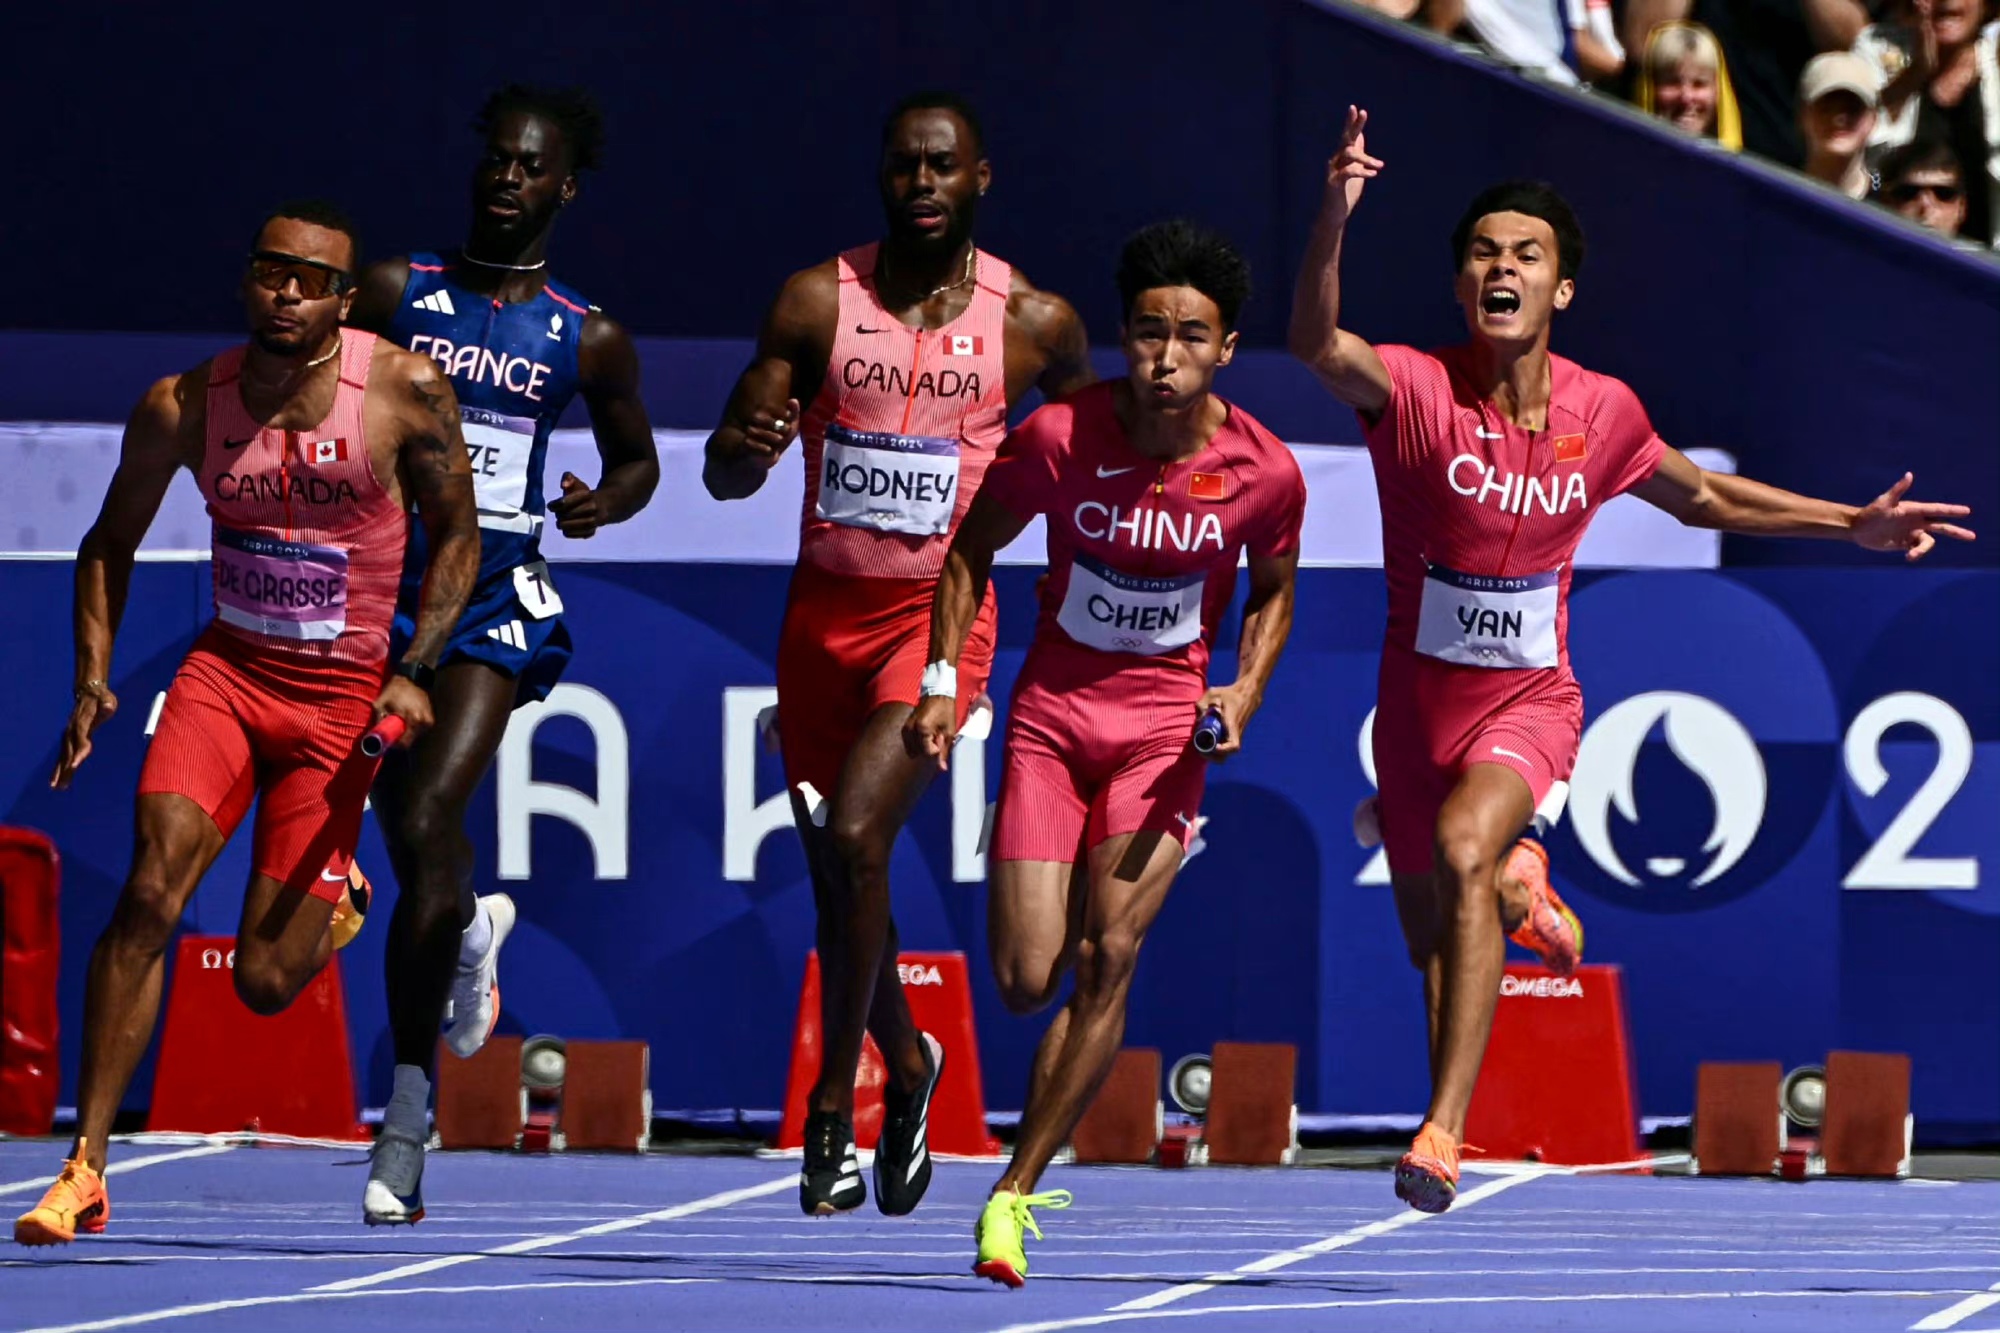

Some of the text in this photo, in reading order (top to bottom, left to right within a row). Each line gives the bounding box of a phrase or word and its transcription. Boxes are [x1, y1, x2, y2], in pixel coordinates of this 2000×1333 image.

[410, 334, 552, 401] FRANCE
[842, 358, 981, 402] CANADA
[852, 433, 924, 449] PARIS 2024
[465, 443, 500, 477] ZE
[214, 472, 360, 505] CANADA
[825, 458, 955, 503] RODNEY
[1447, 453, 1588, 517] CHINA
[1074, 500, 1225, 552] CHINA
[218, 560, 342, 608] DE GRASSE
[1103, 568, 1138, 588] PARIS
[1458, 575, 1529, 589] PARIS 2024
[1088, 593, 1181, 631] CHEN
[1457, 604, 1523, 638] YAN
[897, 963, 943, 987] EGA
[1500, 974, 1584, 998] OMEGA
